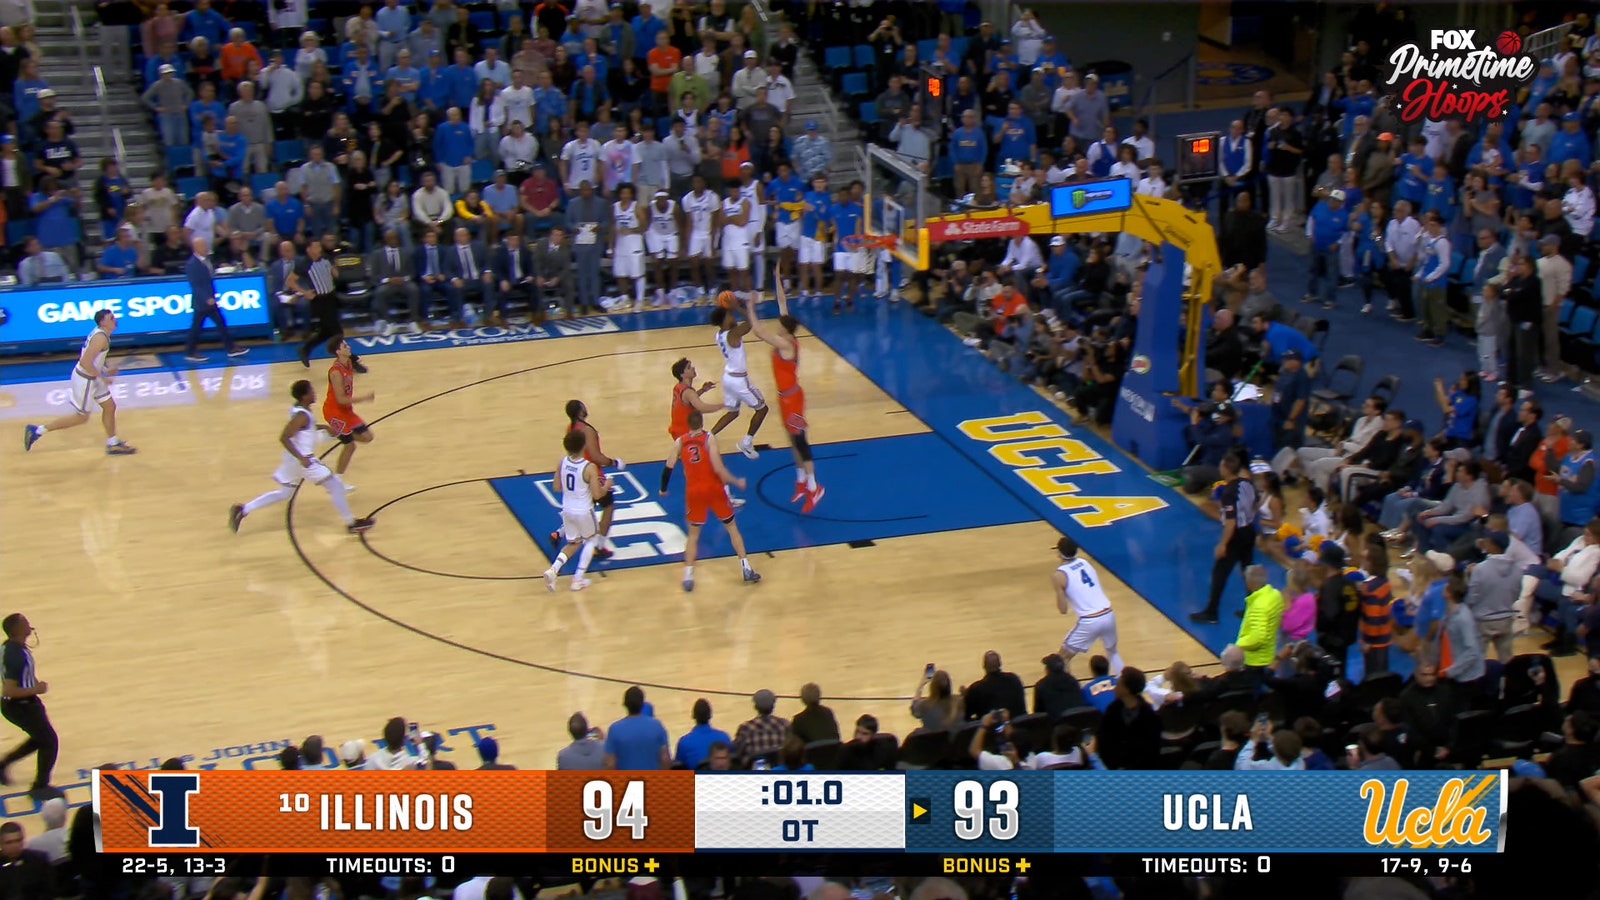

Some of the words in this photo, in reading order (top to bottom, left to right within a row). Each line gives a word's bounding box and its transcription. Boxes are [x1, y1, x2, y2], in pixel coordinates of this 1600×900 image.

[38, 299, 123, 323] GAME
[128, 289, 261, 318] SPOOR
[687, 445, 701, 463] 3
[956, 410, 1170, 528] UCLA
[566, 473, 575, 491] 0
[1081, 569, 1095, 588] 4
[202, 739, 291, 761] JOHN
